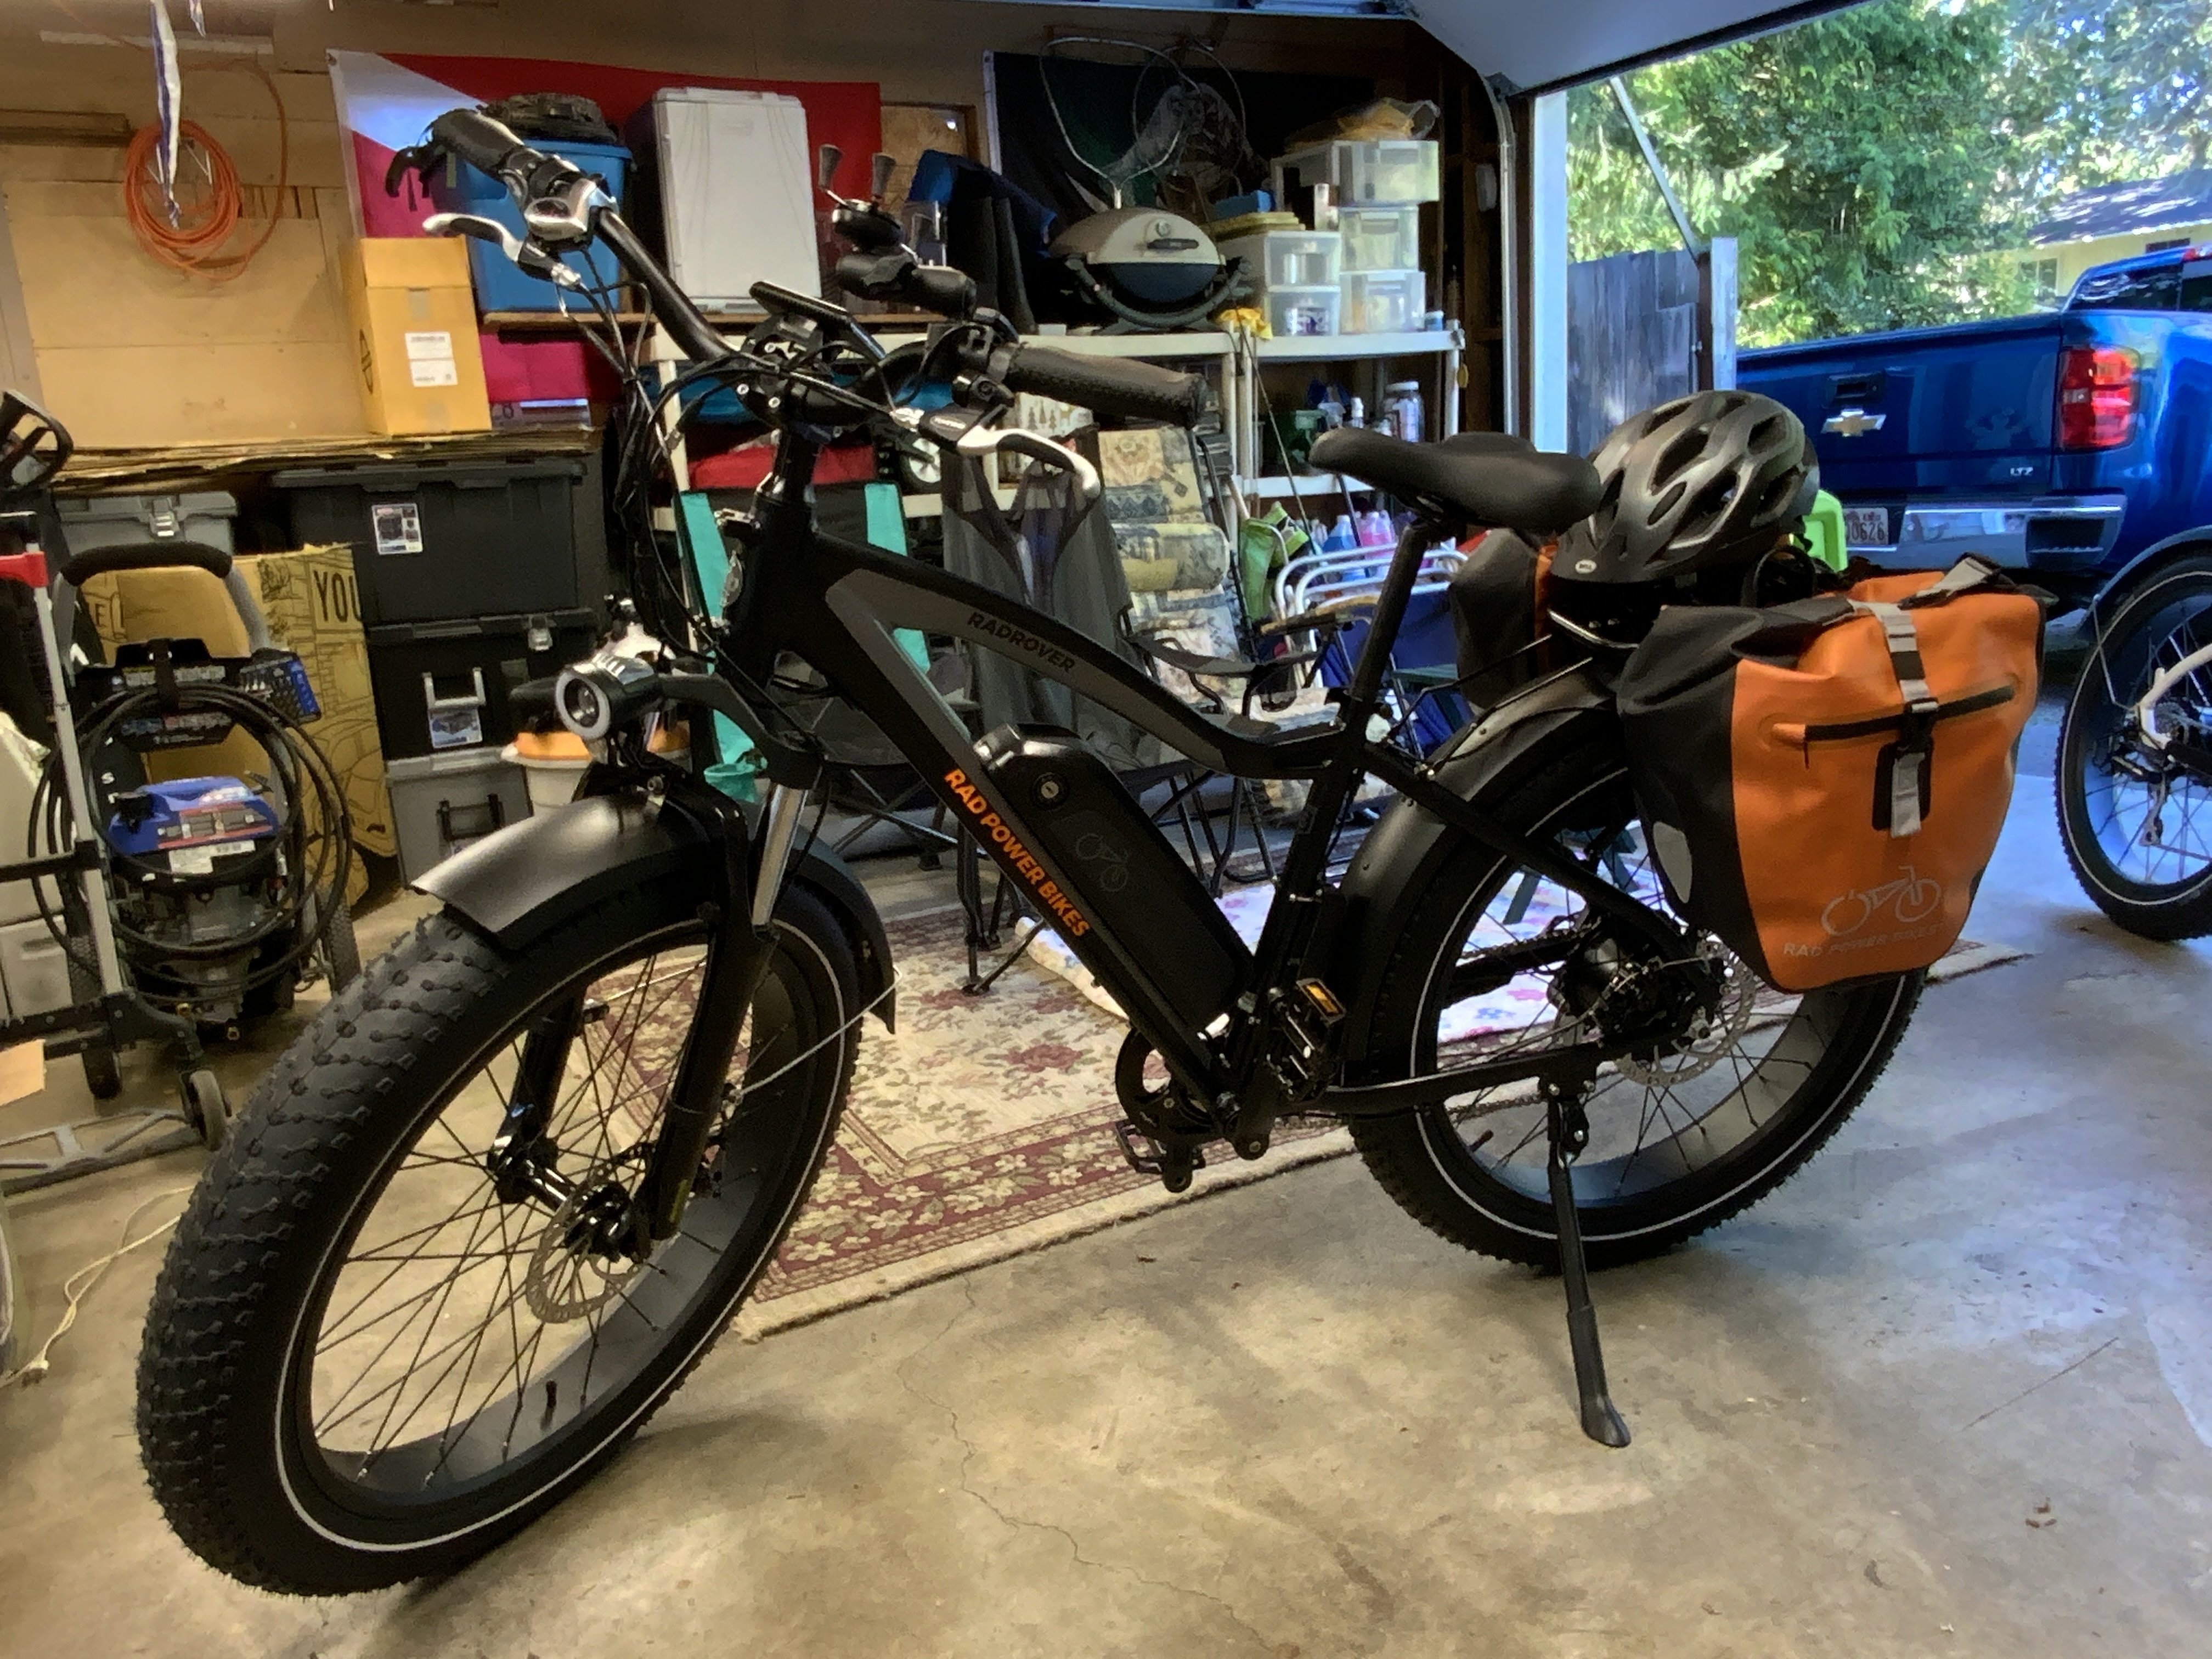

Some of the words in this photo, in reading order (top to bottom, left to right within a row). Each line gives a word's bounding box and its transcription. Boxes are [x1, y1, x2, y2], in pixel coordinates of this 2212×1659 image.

[2010, 467, 2033, 476] LTZ
[967, 612, 1075, 673] RADROVER
[944, 769, 987, 814] RAD
[980, 812, 1045, 885] POWER
[1037, 881, 1090, 936] BIKES
[1784, 943, 1822, 957] RAD
